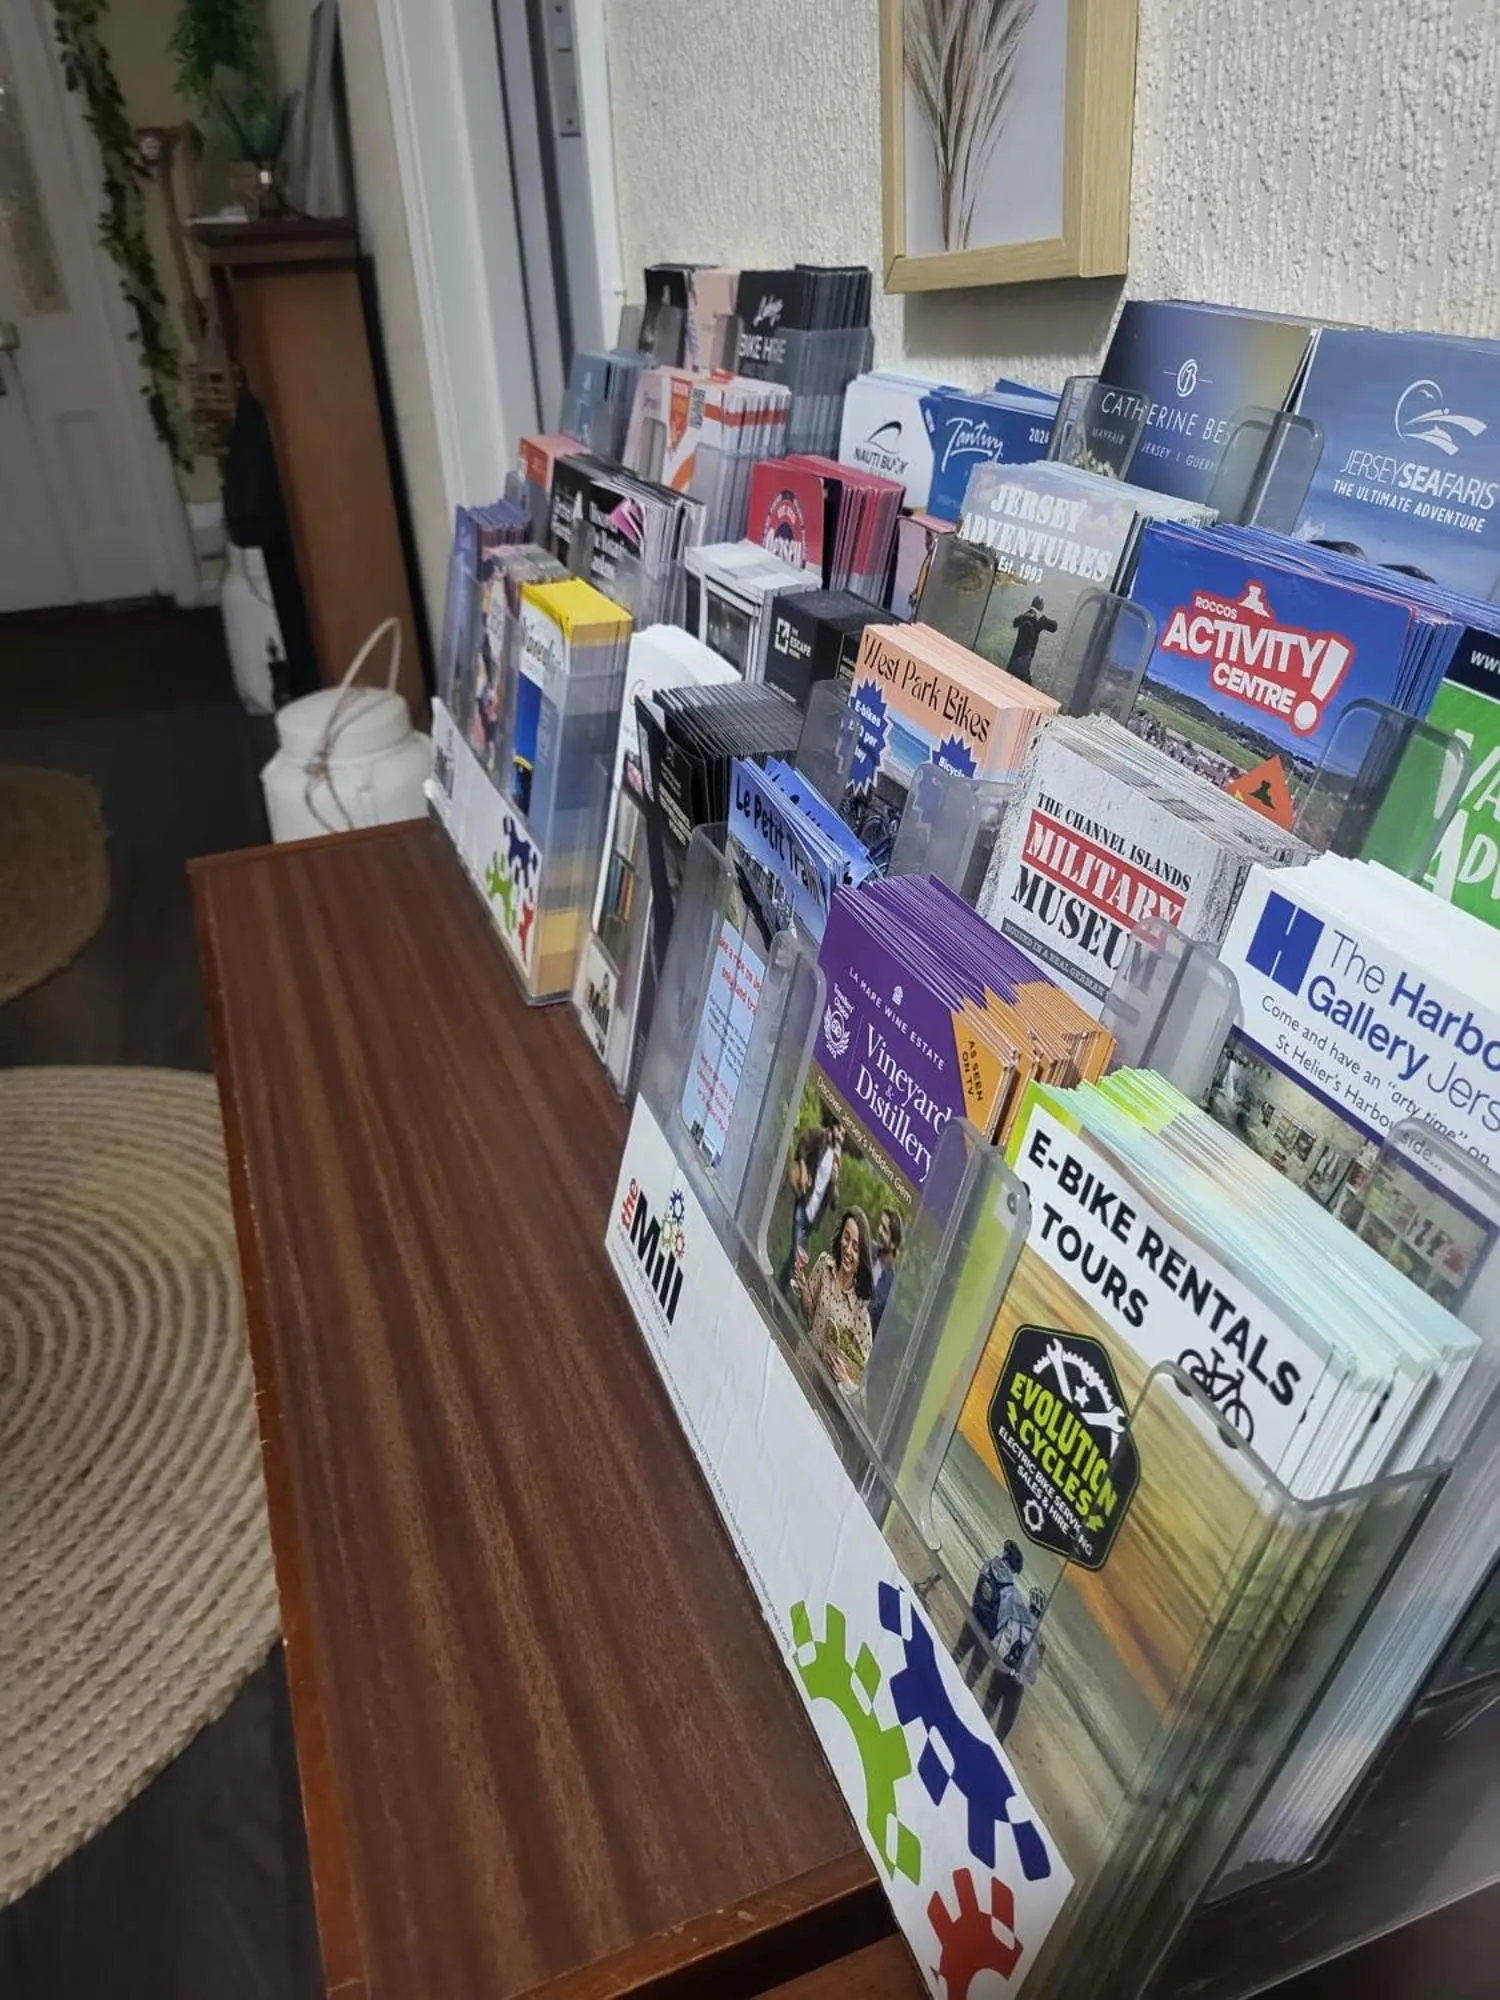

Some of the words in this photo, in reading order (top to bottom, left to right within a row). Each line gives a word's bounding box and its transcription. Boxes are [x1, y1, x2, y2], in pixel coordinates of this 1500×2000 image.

[1102, 392, 1199, 436] CATHERINE
[1140, 442, 1171, 458] JERSEY
[991, 484, 1088, 532] JERSEY
[1333, 480, 1354, 496] THE
[1356, 485, 1412, 513] ULTIMATE
[1413, 502, 1487, 533] ADVENTURE
[957, 512, 1113, 582] ADVENTURES
[997, 556, 1015, 575] Est.
[1019, 564, 1043, 584] 1993
[1196, 596, 1238, 620] ROCCOS
[855, 699, 880, 727] E-bikes
[864, 634, 900, 683] West
[901, 660, 941, 711] Park
[942, 685, 990, 742] Bikes
[1213, 663, 1296, 714] CENTRE
[736, 776, 750, 818] Le
[754, 794, 785, 861] Petit
[787, 834, 821, 904] Train
[1025, 820, 1183, 924] MILITARY
[1038, 792, 1063, 818] THE
[1065, 808, 1126, 855] CHANNEL
[1129, 844, 1192, 892] ISLANDS
[1329, 929, 1385, 994] The
[849, 966, 858, 983] LA
[860, 980, 882, 1008] MARE
[884, 1005, 908, 1034] WINE
[910, 1031, 945, 1071] ESTATE
[1262, 995, 1299, 1031] Come
[1302, 1024, 1328, 1051] and
[1329, 1040, 1361, 1074] have
[1363, 1069, 1381, 1090] an
[1308, 975, 1430, 1081] Gallery
[867, 1022, 952, 1135] Vineyard
[885, 1084, 895, 1100] &
[962, 1051, 971, 1072] ON
[966, 1077, 974, 1095] TV
[968, 1040, 976, 1058] AS
[972, 1063, 983, 1101] SEEN
[1276, 1034, 1290, 1053] St
[1292, 1046, 1342, 1092] Helier's
[816, 1075, 843, 1113] Discover
[868, 1146, 894, 1182] Hidden
[854, 1064, 932, 1183] Distillery
[630, 1189, 684, 1325] Mill
[1027, 1129, 1136, 1244] E-BIKE
[1137, 1226, 1301, 1406] RENTALS
[1039, 1203, 1149, 1328] TOURS
[999, 1426, 1036, 1475] ELECTRIC
[1035, 1470, 1054, 1499] BIKE
[1009, 1372, 1118, 1516] EVOLUTION
[1019, 1419, 1093, 1516] CYCLES
[1017, 1465, 1043, 1499] SALES
[1050, 1506, 1069, 1536] HIRE
